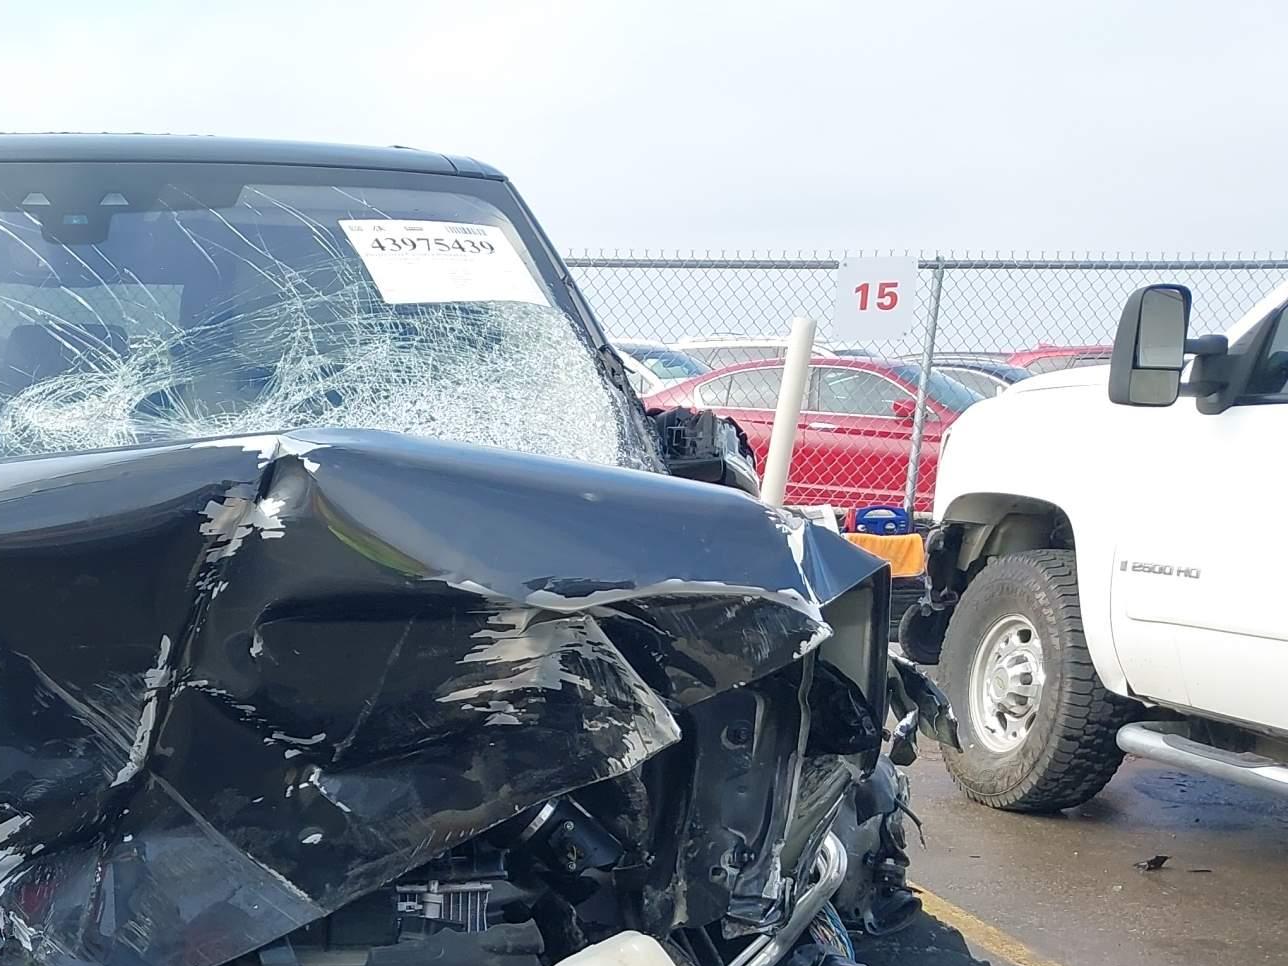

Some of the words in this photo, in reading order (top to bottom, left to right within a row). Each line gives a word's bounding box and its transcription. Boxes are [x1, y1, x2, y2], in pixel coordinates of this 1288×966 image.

[371, 237, 495, 255] 43975439
[854, 282, 899, 311] 15
[1131, 561, 1173, 576] 2500
